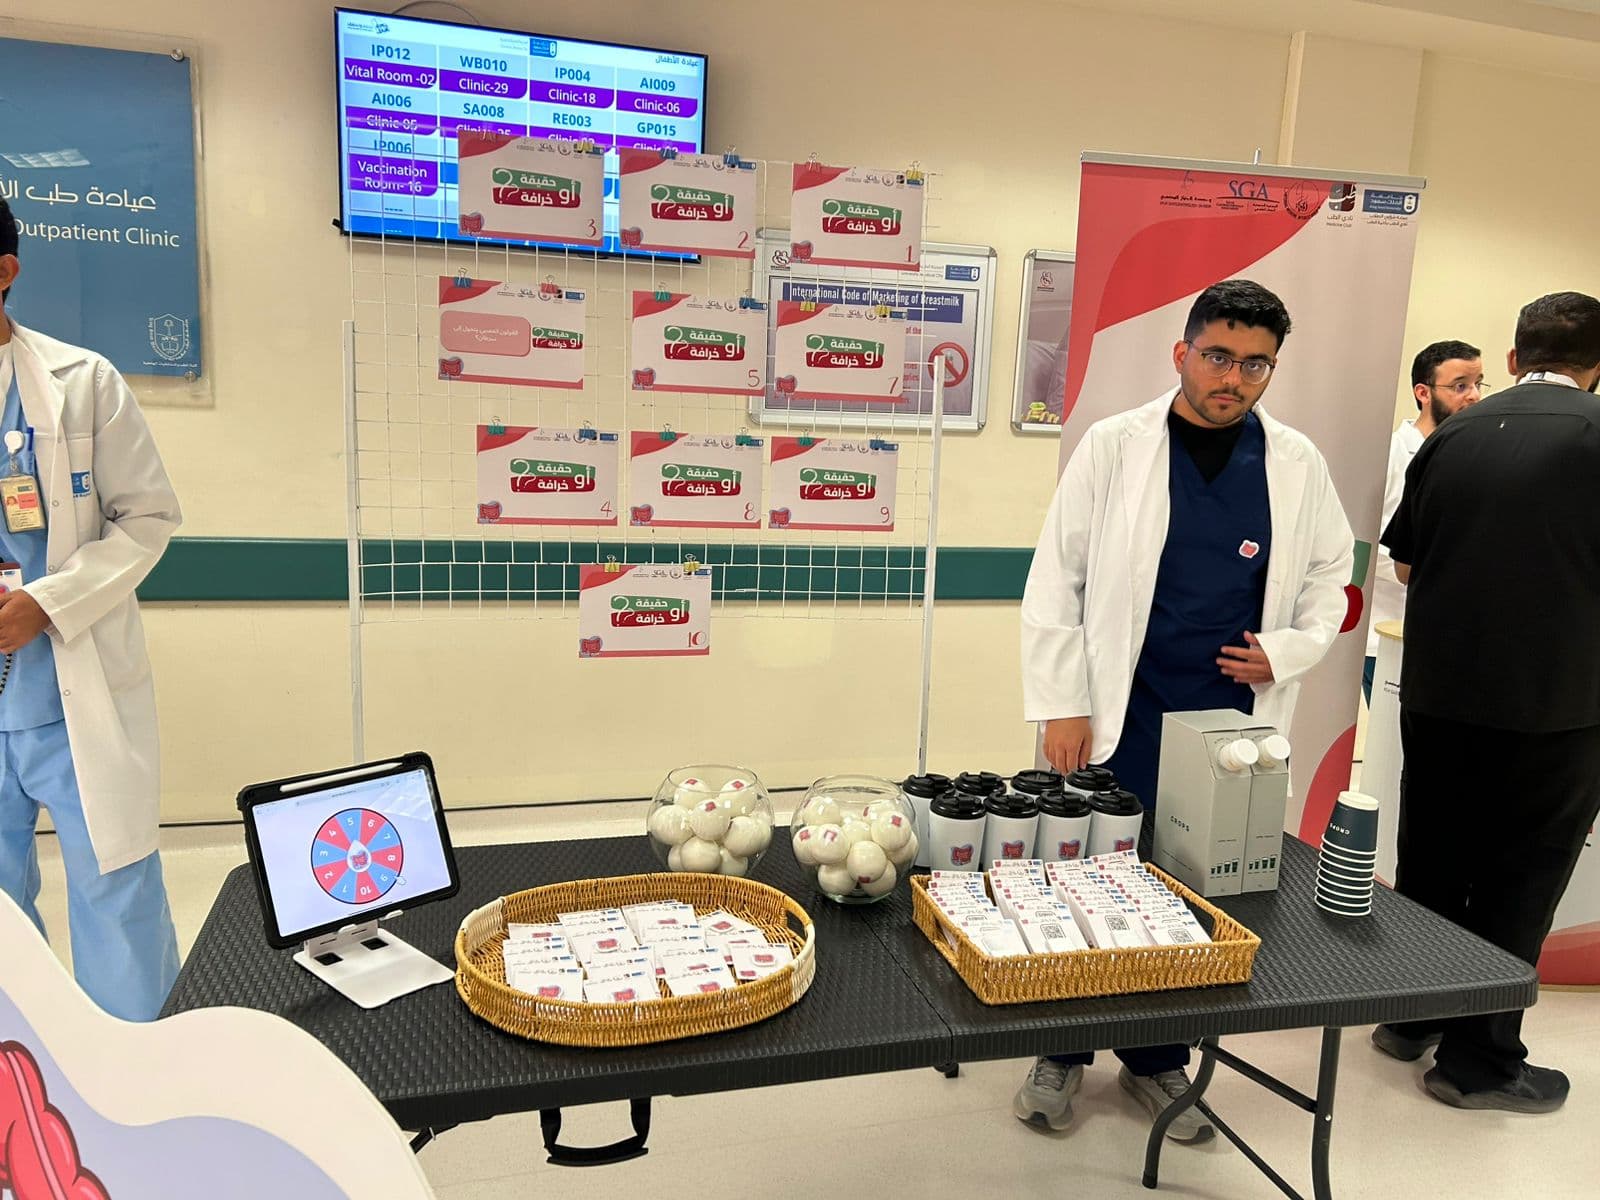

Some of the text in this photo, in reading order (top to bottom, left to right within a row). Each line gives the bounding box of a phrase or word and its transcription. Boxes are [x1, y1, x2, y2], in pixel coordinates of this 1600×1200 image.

[371, 44, 411, 60] IP012
[460, 55, 507, 72] WB010
[346, 64, 435, 86] Vital Room -02
[555, 66, 591, 82] IP004
[458, 78, 509, 94] Clinic-29
[640, 77, 676, 92] AI009
[372, 92, 412, 108] AI006
[548, 88, 596, 104] Clinic-18
[463, 103, 505, 119] SA008
[634, 98, 680, 114] Clinic-06
[553, 112, 592, 128] RE003
[637, 122, 677, 137] GP015
[358, 160, 428, 178] Vaccination
[520, 174, 556, 188] حقيقة
[26, 183, 78, 206] طب
[559, 180, 576, 205] أو
[677, 189, 711, 202] حقيقة
[1229, 180, 1269, 199] SGA
[86, 186, 157, 212] عيادة
[520, 191, 553, 207] خرافة
[713, 194, 729, 218] أو
[677, 206, 708, 220] خرافة
[847, 204, 880, 217] حقيقة
[587, 218, 597, 237] 3
[847, 221, 876, 234] خرافة
[882, 209, 897, 232] أو
[125, 227, 180, 248] Clinic
[737, 231, 749, 249] 2
[906, 245, 913, 262] 1
[862, 291, 871, 301] of
[872, 291, 910, 306] Markeing
[911, 293, 920, 304] of
[689, 330, 723, 343] حقيقة
[689, 346, 720, 360] خرافة
[725, 334, 741, 357] أو
[830, 339, 863, 352] حقيقة
[864, 342, 879, 365] أو
[830, 355, 859, 368] خرافة
[747, 369, 760, 388] 5
[887, 376, 899, 394] 7
[536, 462, 572, 475] حقيقة
[686, 467, 719, 480] حقيقة
[574, 465, 591, 489] أو
[721, 470, 736, 493] أو
[823, 471, 855, 484] حقيقة
[537, 479, 569, 492] خرافة
[686, 483, 716, 497] خرافة
[823, 487, 852, 500] خرافة
[857, 475, 872, 497] أو
[600, 500, 612, 518] 4
[744, 502, 756, 520] 8
[880, 506, 890, 524] 9
[635, 598, 668, 610] حقيقة
[669, 600, 685, 622] أو
[636, 613, 665, 625] خرافة
[347, 817, 354, 826] 5
[367, 819, 376, 828] 6
[328, 829, 337, 837] 4
[324, 871, 334, 879] 2
[380, 874, 388, 882] 9
[360, 885, 372, 895] 10
